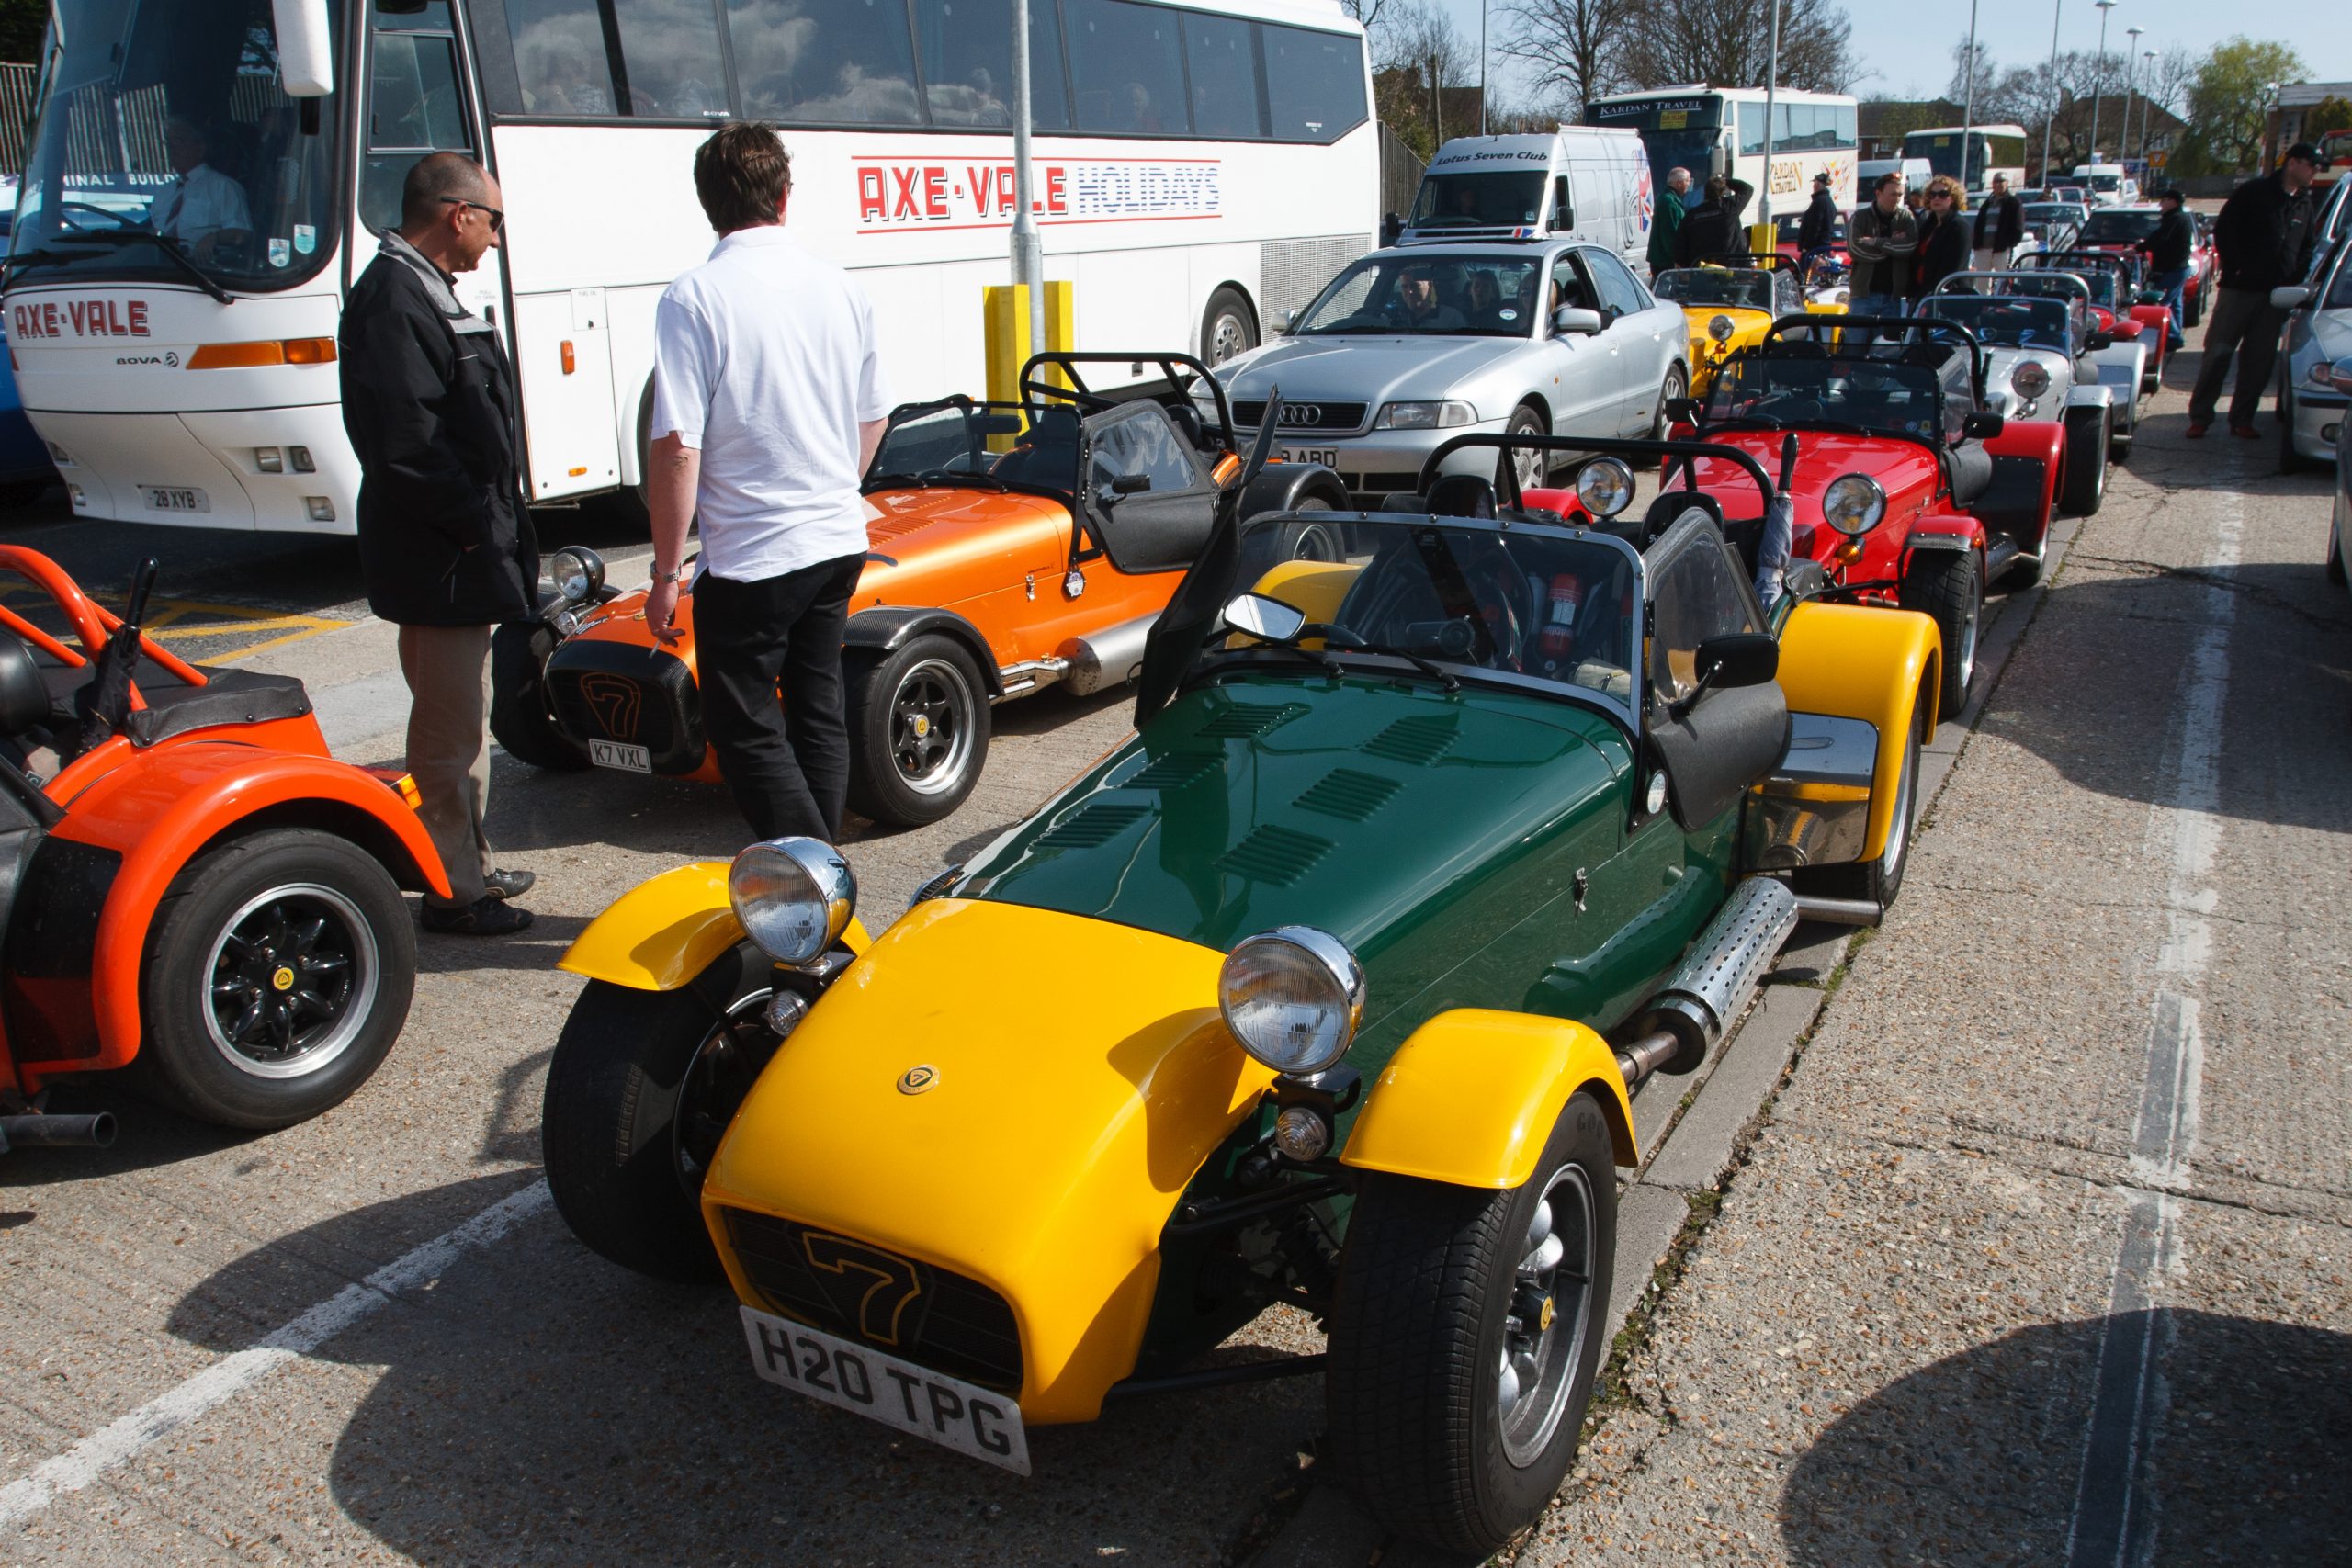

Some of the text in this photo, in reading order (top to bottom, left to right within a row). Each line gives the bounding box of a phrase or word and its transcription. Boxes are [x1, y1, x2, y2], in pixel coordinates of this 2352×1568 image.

[1600, 100, 1702, 116] KARDAN TRAVEL
[1436, 151, 1548, 165] Lotus Seven Club
[1077, 166, 1220, 214] HOLIDAYS
[116, 356, 162, 365] BOVA
[153, 490, 196, 509] 28 XYB
[594, 743, 647, 769] K7 VXL
[802, 1231, 922, 1346] 7
[885, 1366, 1012, 1457] TPG
